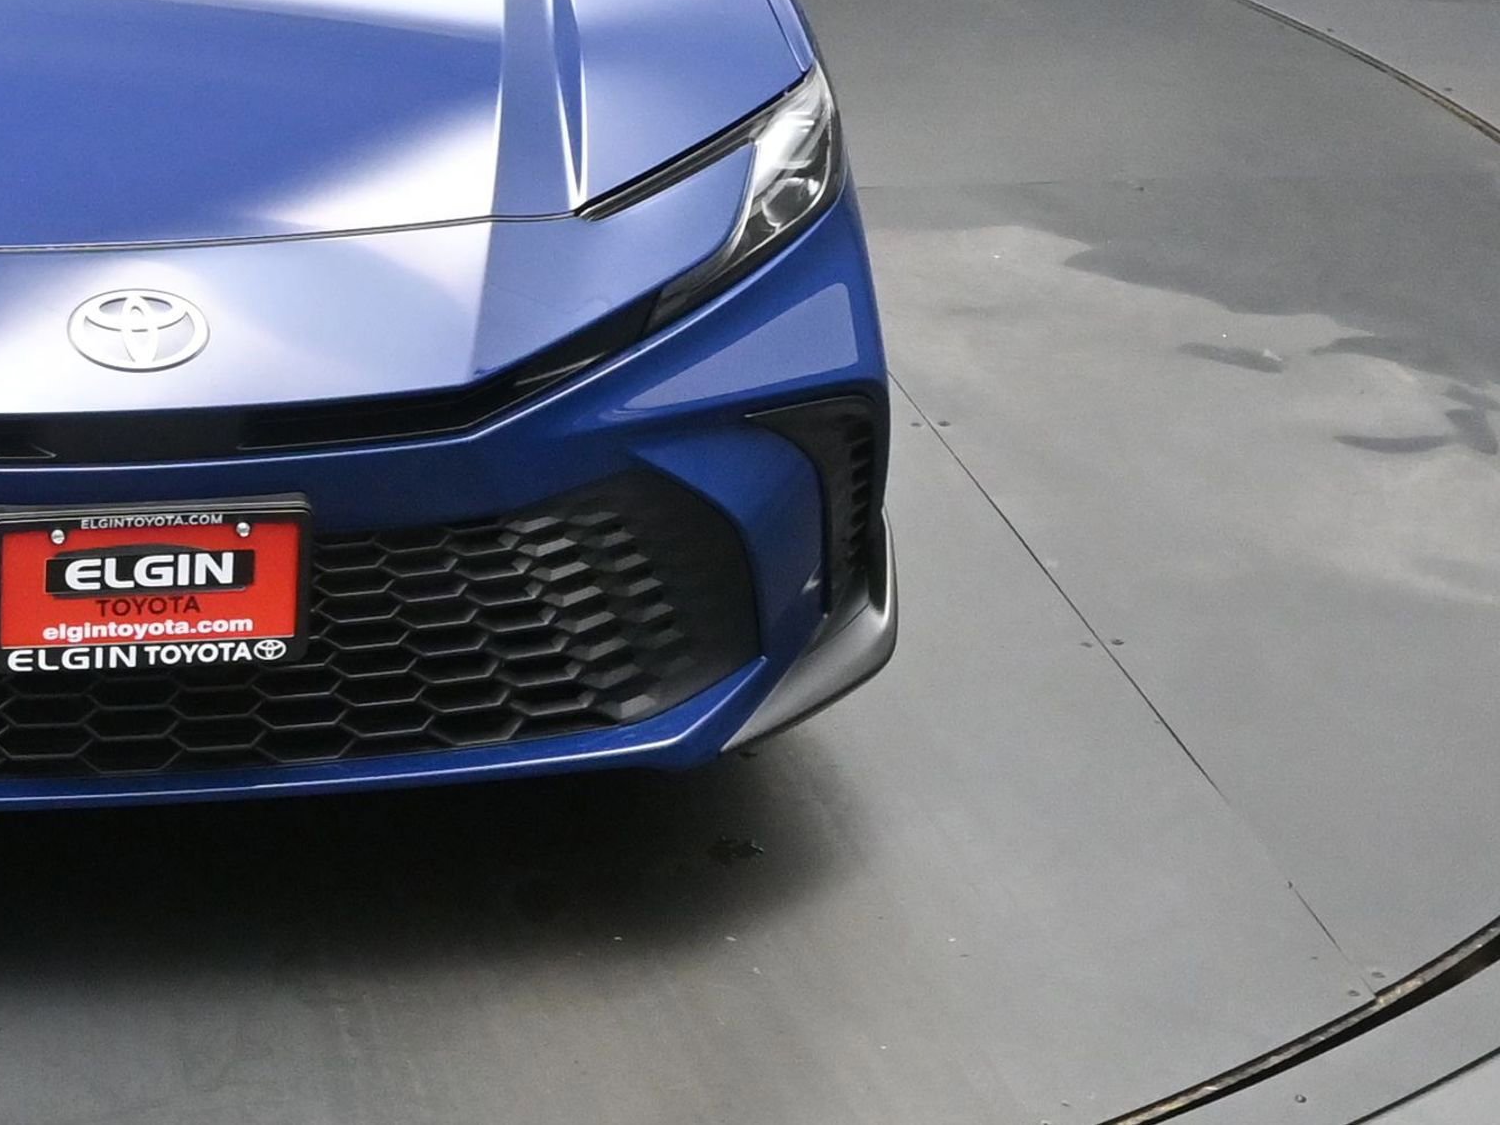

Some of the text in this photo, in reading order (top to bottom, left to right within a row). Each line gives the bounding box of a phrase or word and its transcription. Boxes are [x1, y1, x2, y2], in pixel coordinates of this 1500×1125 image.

[80, 514, 223, 529] ELGINTOYOTA.COM
[64, 551, 234, 591] ELGIN
[96, 595, 201, 617] TOYOTA
[42, 617, 254, 643] elgintoyota.com
[7, 641, 252, 672] ELGIN TOYOTA
